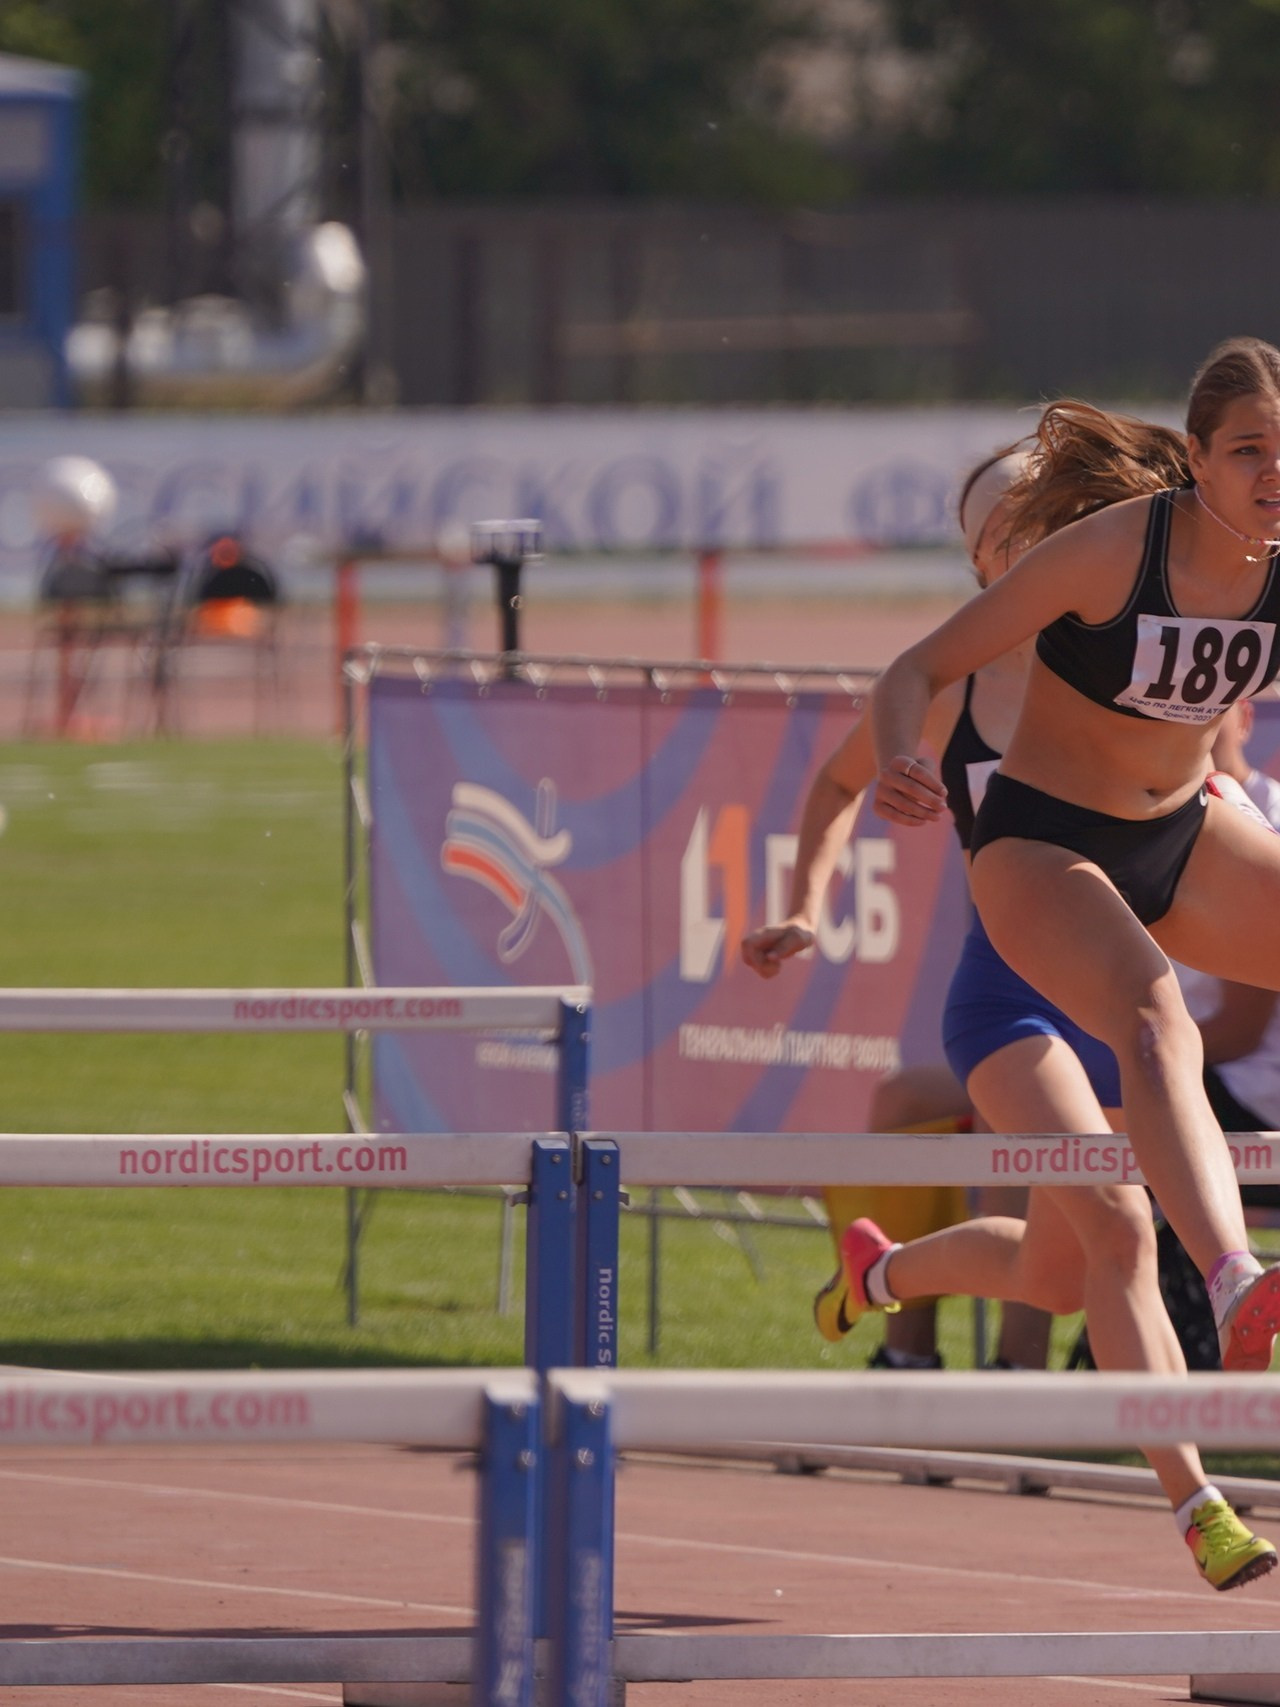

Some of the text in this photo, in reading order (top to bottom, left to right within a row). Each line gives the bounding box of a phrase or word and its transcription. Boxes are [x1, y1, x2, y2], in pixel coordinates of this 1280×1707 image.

[1143, 626, 1262, 704] 189
[1168, 704, 1205, 714] ЛЕГКОЙ
[234, 995, 462, 1027] nordicsport.com
[119, 1140, 408, 1181] nordicsport.com
[991, 1137, 1273, 1181] nordicspm
[597, 1267, 614, 1343] nordic
